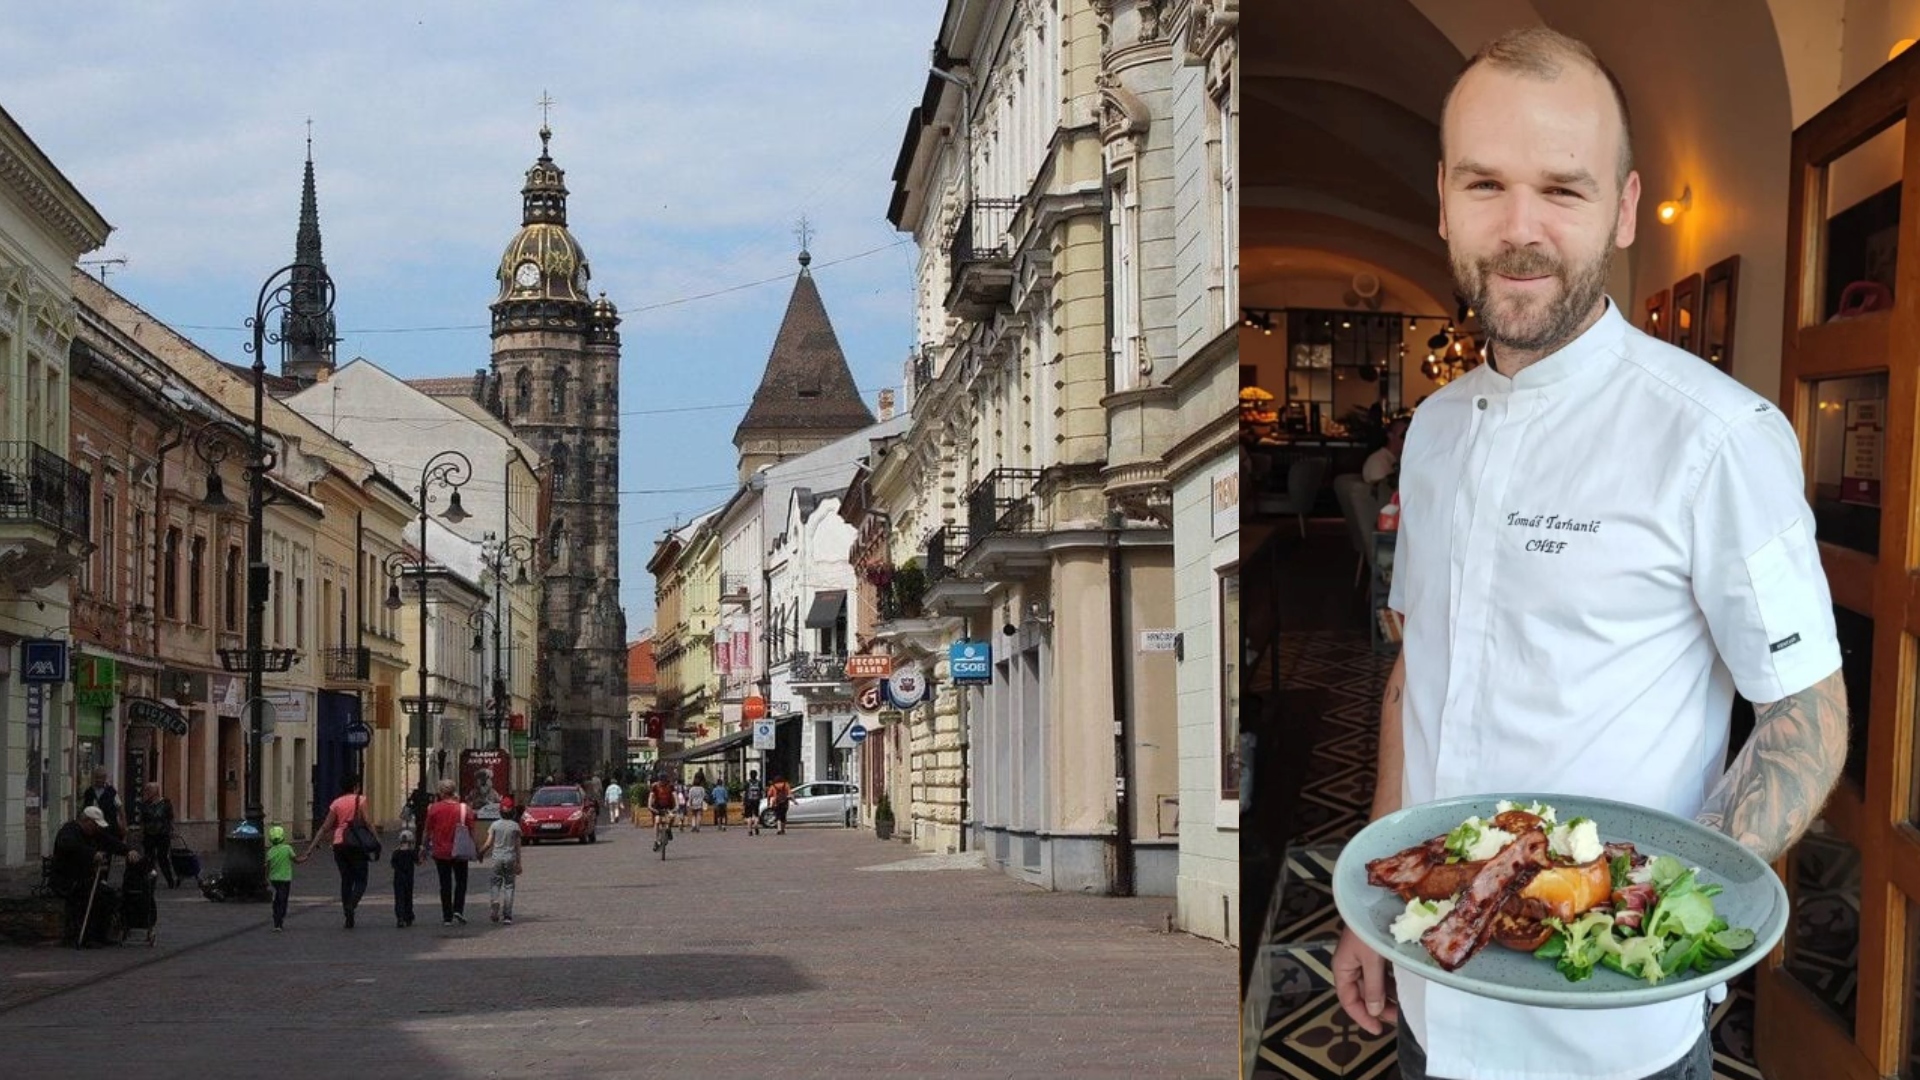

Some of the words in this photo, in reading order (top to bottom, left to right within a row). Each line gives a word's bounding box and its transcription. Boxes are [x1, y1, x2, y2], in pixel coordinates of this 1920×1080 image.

[1507, 511, 1544, 529] Tomáš
[1546, 514, 1602, 534] Tarhanič
[1525, 538, 1569, 554] CHEF
[26, 660, 55, 675] AXA
[850, 658, 888, 667] SECOND
[856, 666, 884, 674] HAND
[79, 692, 111, 704] DAY
